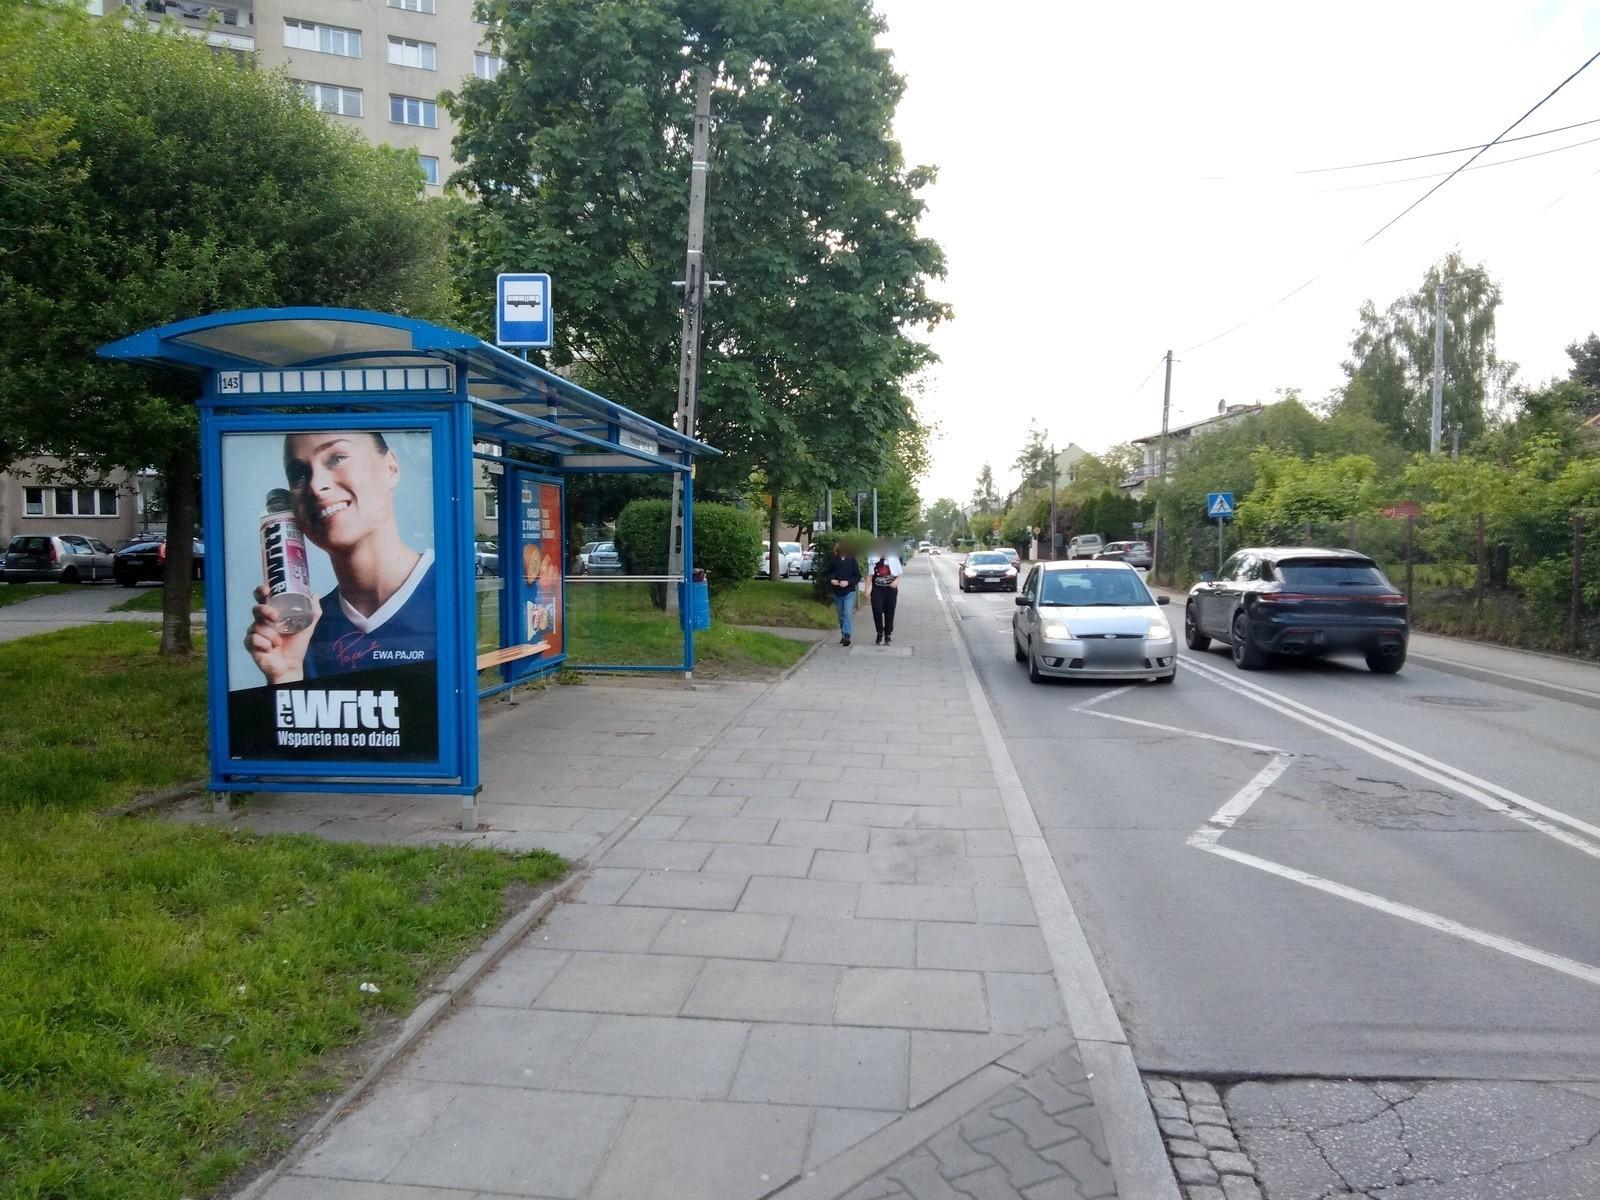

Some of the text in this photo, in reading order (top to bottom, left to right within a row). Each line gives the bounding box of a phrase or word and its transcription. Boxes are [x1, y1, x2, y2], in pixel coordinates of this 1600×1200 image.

[222, 377, 239, 389] 143
[264, 523, 286, 586] Witt
[373, 650, 425, 660] EWA PAJOR
[279, 704, 294, 725] dr
[291, 689, 400, 729] Witt
[278, 729, 400, 748] Wsparcie na co dzień
